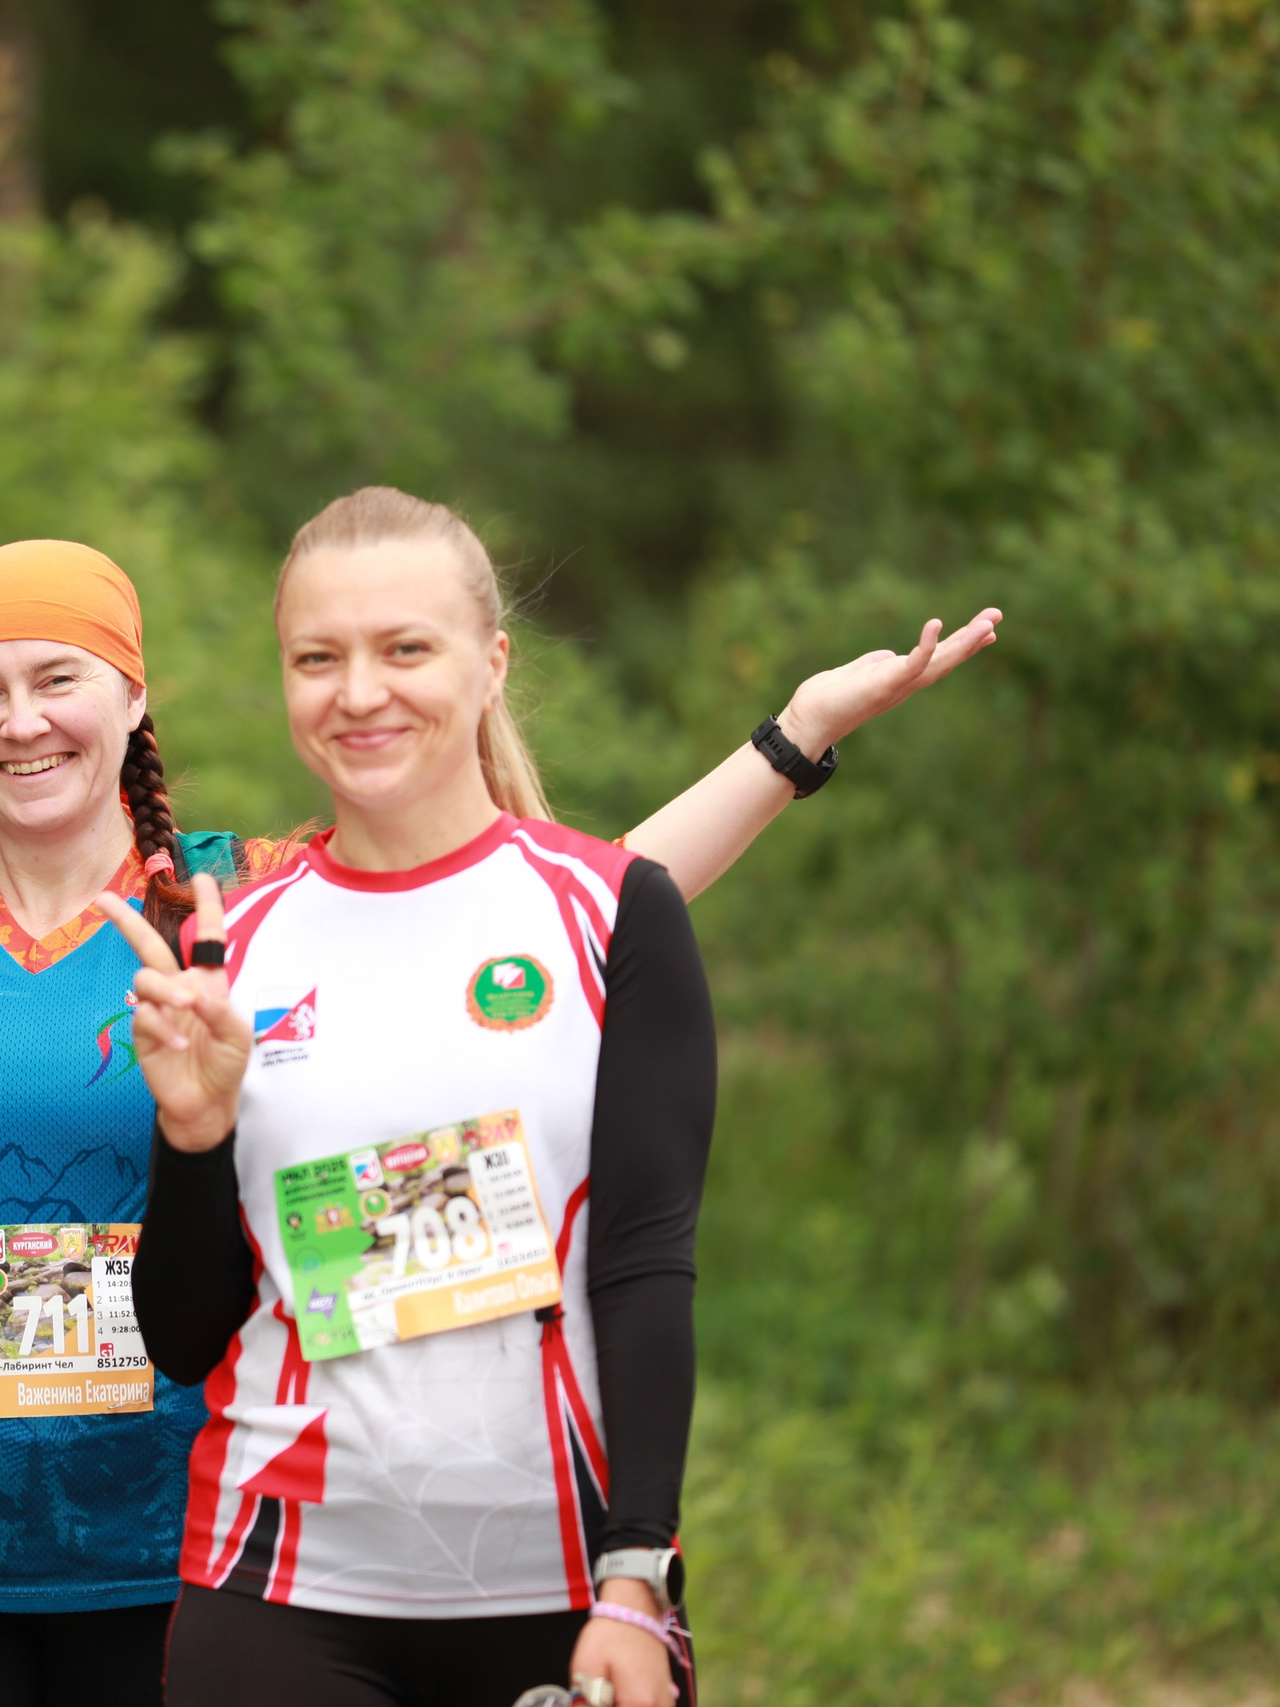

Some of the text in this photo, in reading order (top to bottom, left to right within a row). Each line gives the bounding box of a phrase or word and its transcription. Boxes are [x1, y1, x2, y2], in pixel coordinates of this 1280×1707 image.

[375, 1195, 488, 1279] 708
[12, 1239, 53, 1251] КУРГАНСКИЙ
[105, 1260, 130, 1275] Ж35
[96, 1296, 103, 1304] 2
[97, 1312, 103, 1320] 3
[13, 1295, 90, 1356] 711
[97, 1327, 104, 1336] 4
[55, 1360, 74, 1369] Чел
[97, 1356, 147, 1369] 8512750
[17, 1377, 150, 1406] Важенина Екатерина
